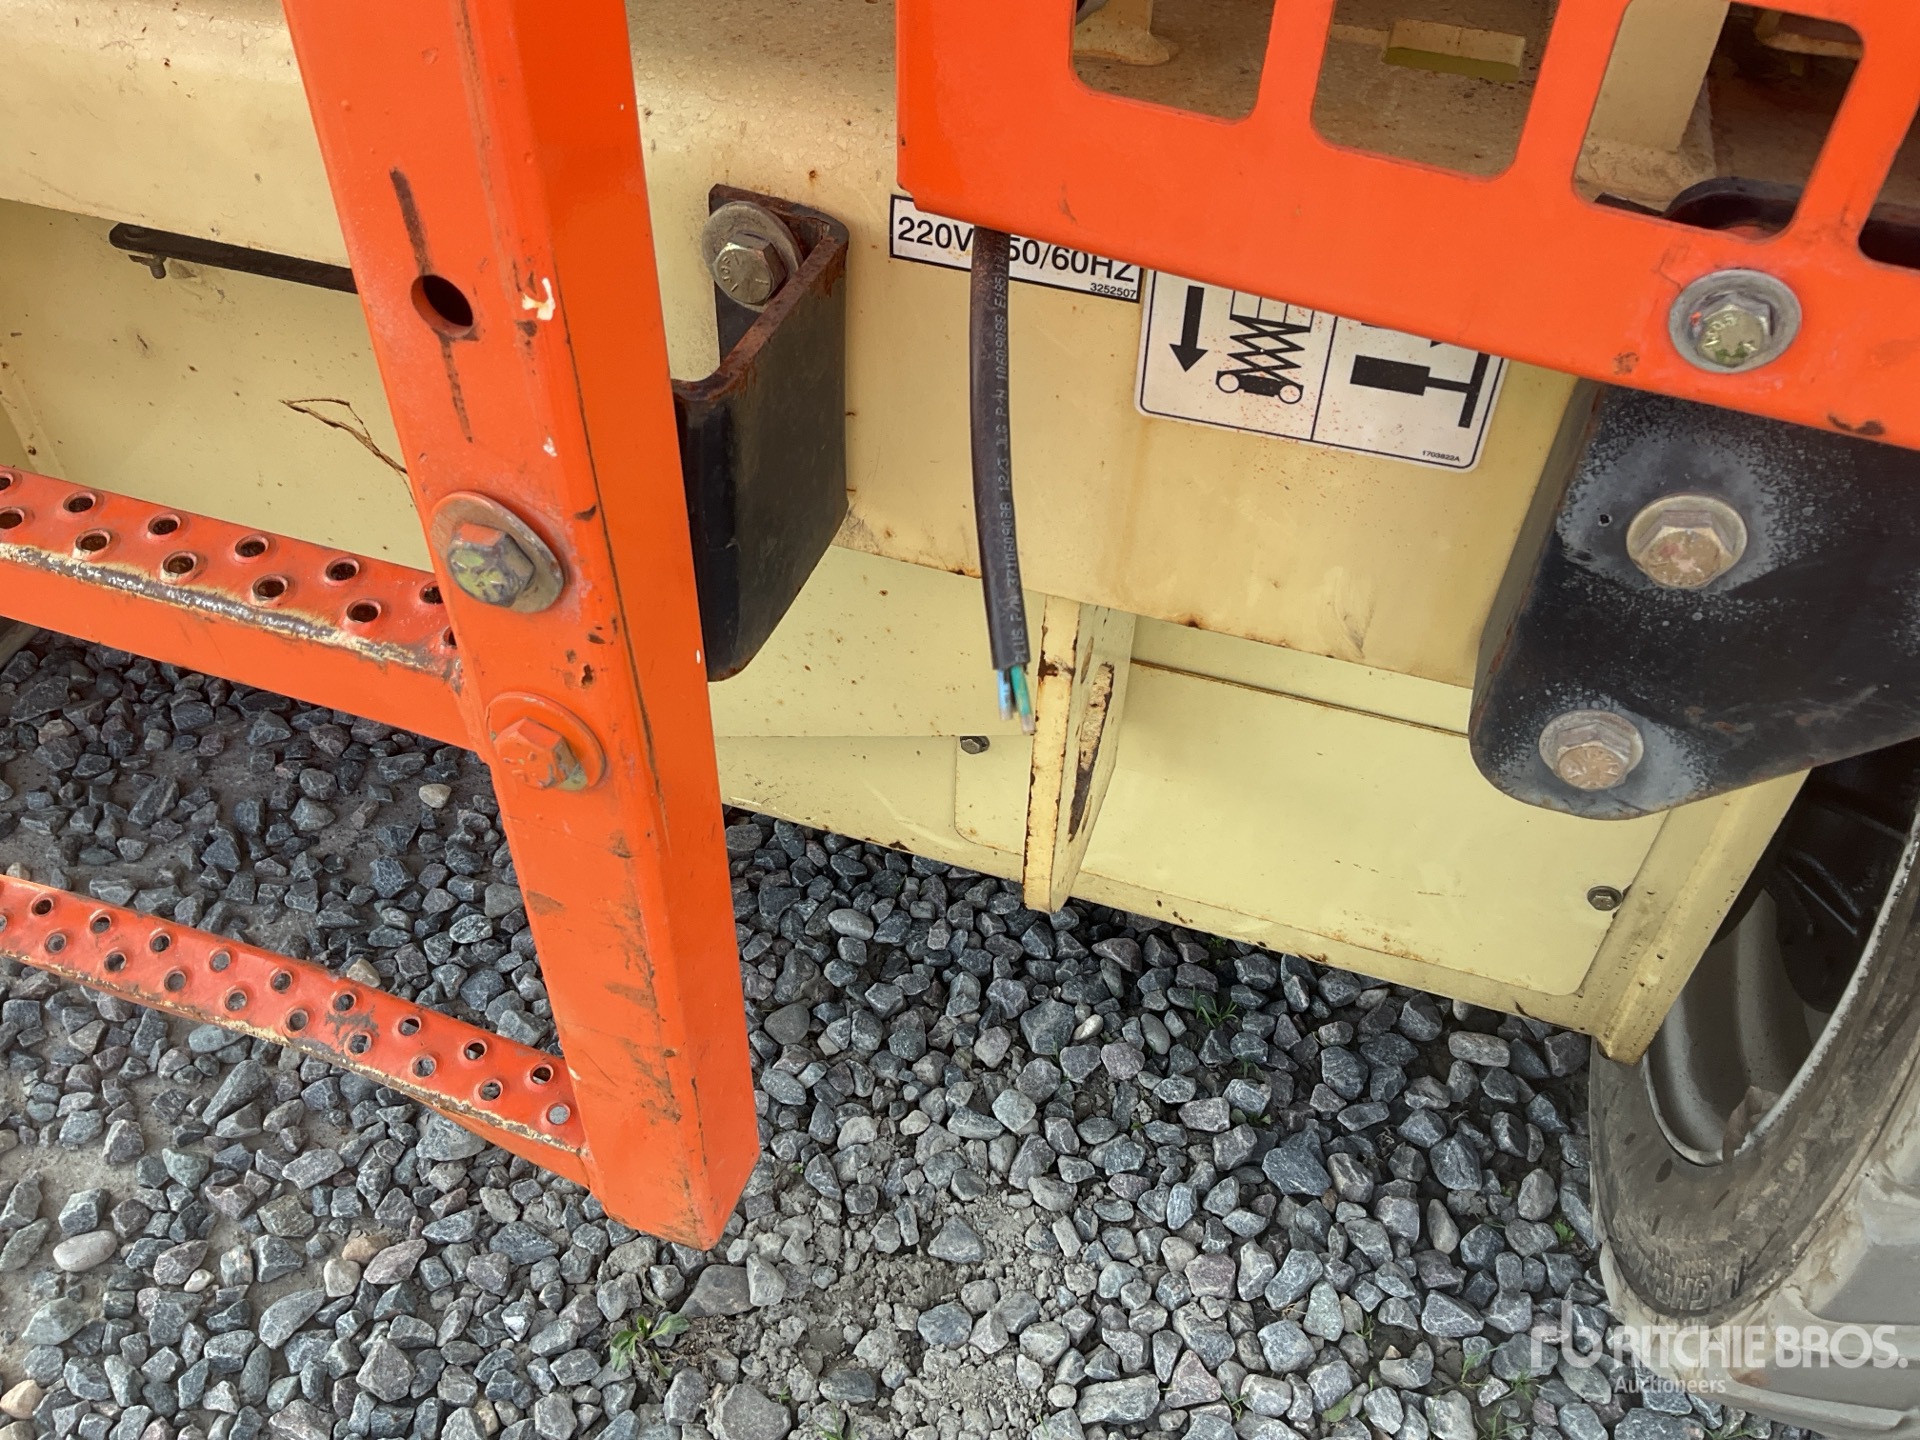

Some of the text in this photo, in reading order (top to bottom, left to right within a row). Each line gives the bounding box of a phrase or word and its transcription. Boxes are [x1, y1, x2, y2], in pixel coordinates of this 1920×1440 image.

[897, 216, 974, 252] 220V
[1090, 282, 1136, 298] 3252507
[1422, 450, 1460, 462] 1703822A
